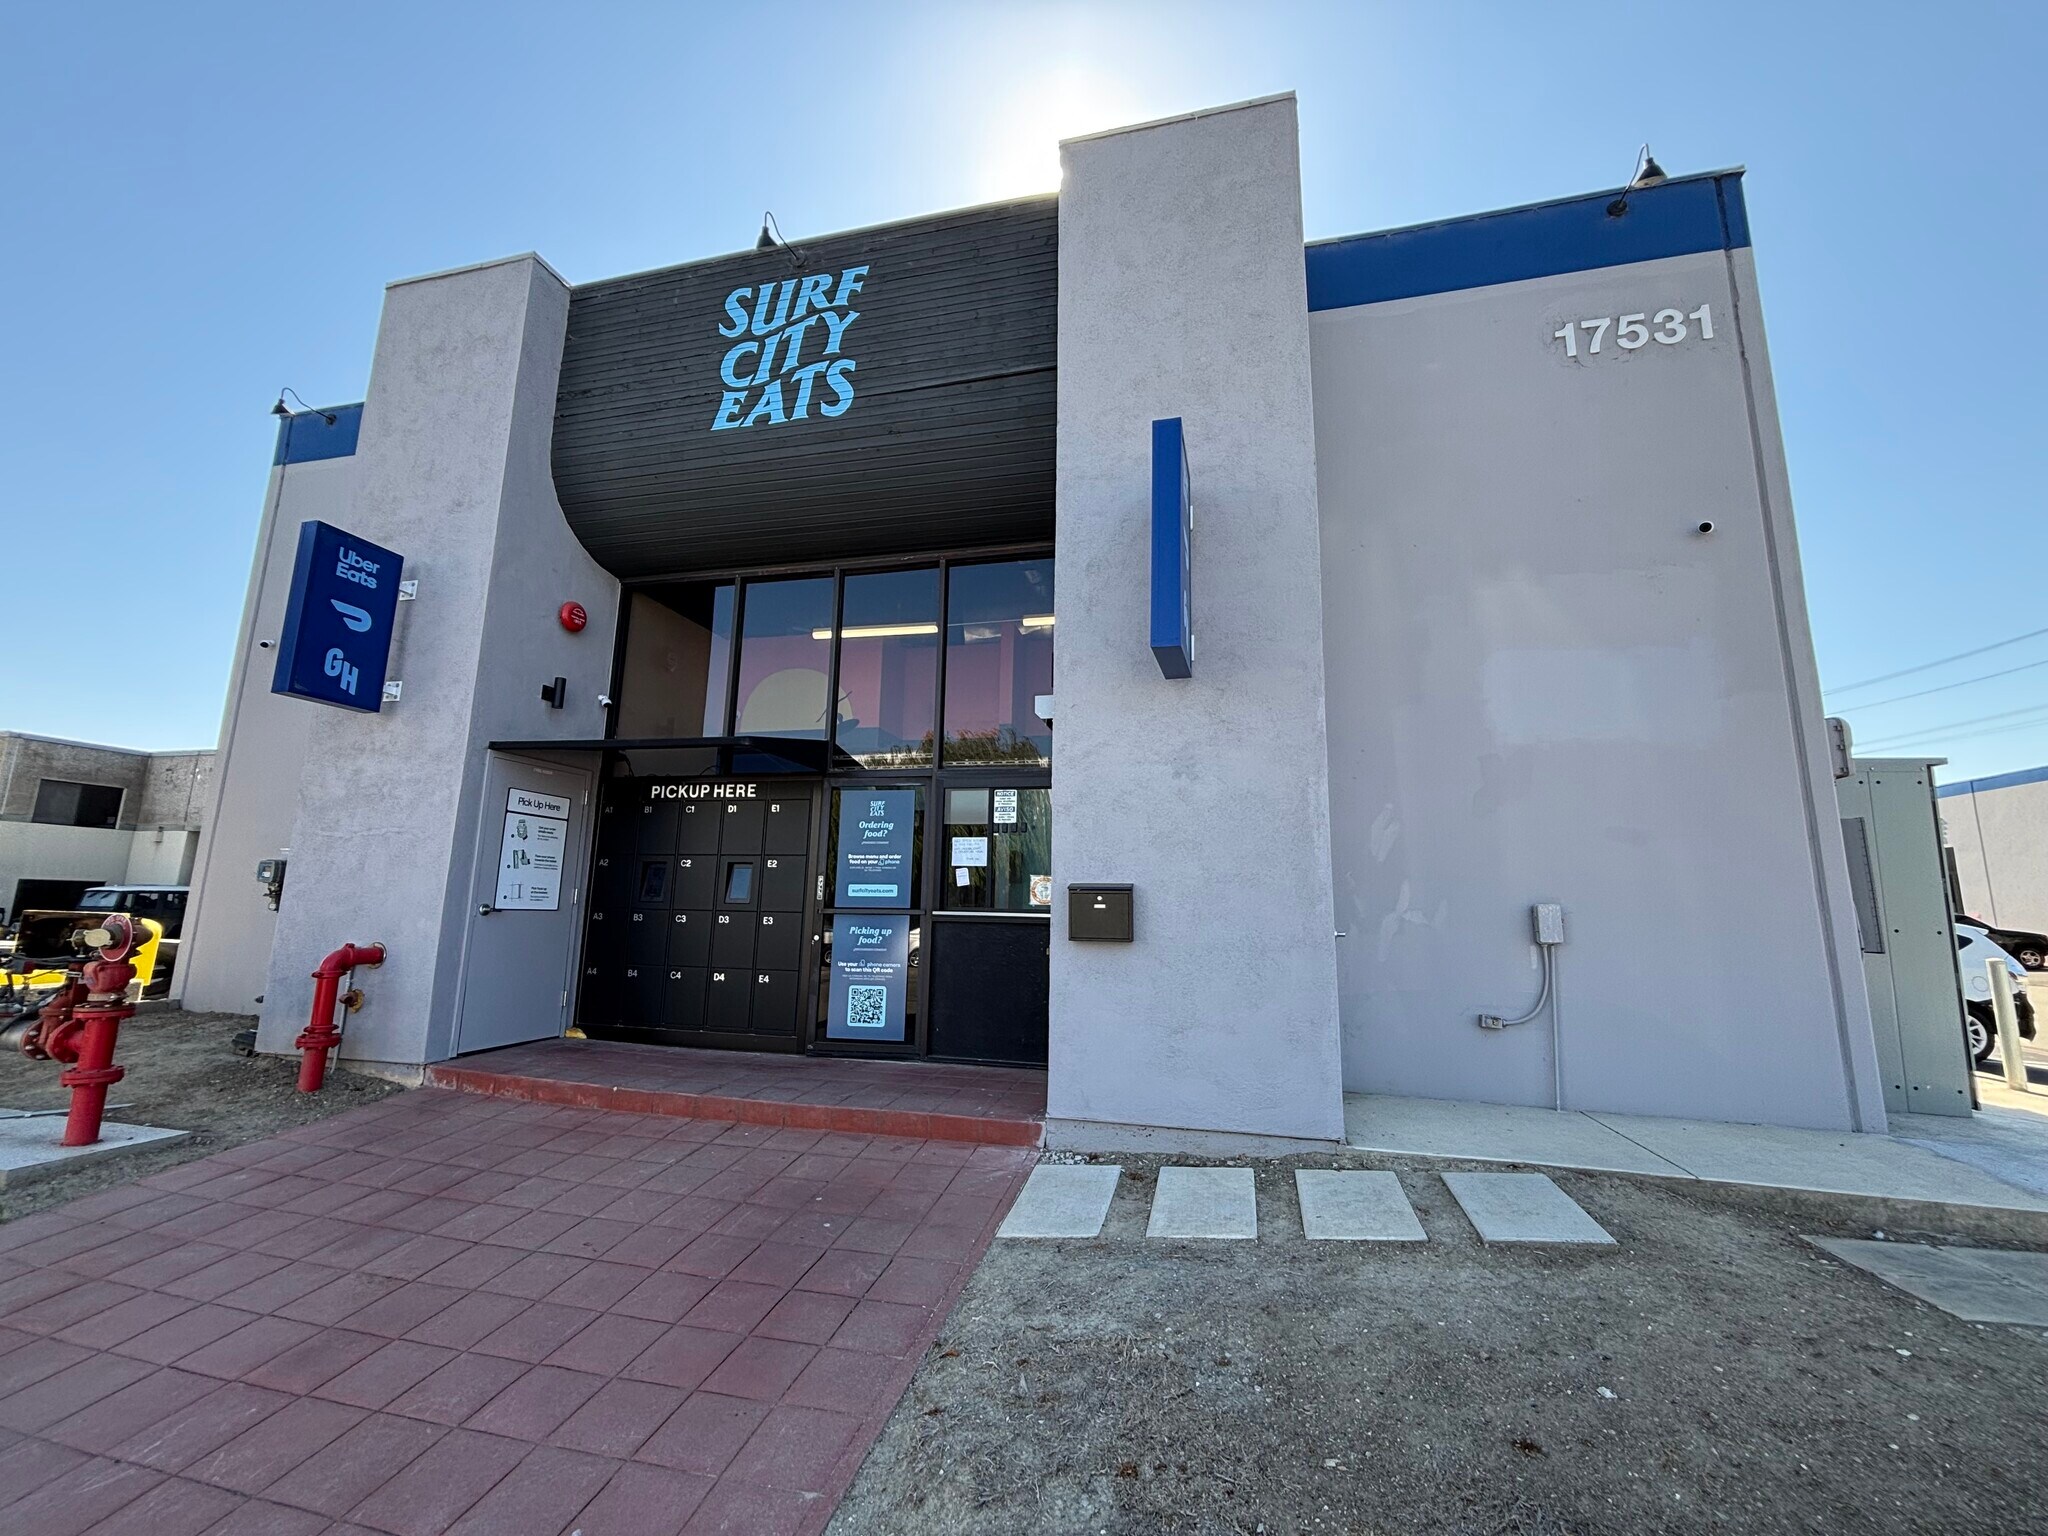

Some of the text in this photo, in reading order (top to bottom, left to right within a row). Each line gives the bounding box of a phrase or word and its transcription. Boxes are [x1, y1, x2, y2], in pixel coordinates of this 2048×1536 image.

[718, 265, 870, 338] SURF
[1554, 303, 1714, 357] 17531
[720, 310, 861, 388] CITY
[710, 358, 856, 431] EATS
[338, 546, 381, 574] Uber
[335, 562, 378, 589] Eats
[323, 647, 359, 696] GH
[651, 783, 757, 799] PICKUP HERE
[518, 796, 560, 812] Pick Up Here
[727, 804, 737, 813] D1
[771, 804, 780, 813] E1
[604, 806, 614, 814] A1
[644, 805, 653, 814] B1
[685, 805, 695, 813] C1
[858, 821, 894, 830] Ordering
[862, 830, 888, 839] food?
[598, 858, 609, 867] A2
[680, 859, 692, 868] C2
[767, 859, 778, 868] E2
[592, 912, 603, 921] A3
[633, 913, 644, 922] B3
[675, 914, 687, 923] C3
[718, 915, 730, 924] D3
[762, 916, 774, 925] E3
[849, 926, 892, 936] Picking up
[857, 936, 883, 945] food?
[587, 967, 597, 975] A4
[627, 969, 638, 977] B4
[670, 970, 682, 980] C4
[713, 972, 725, 982] D4
[758, 974, 770, 984] E4
